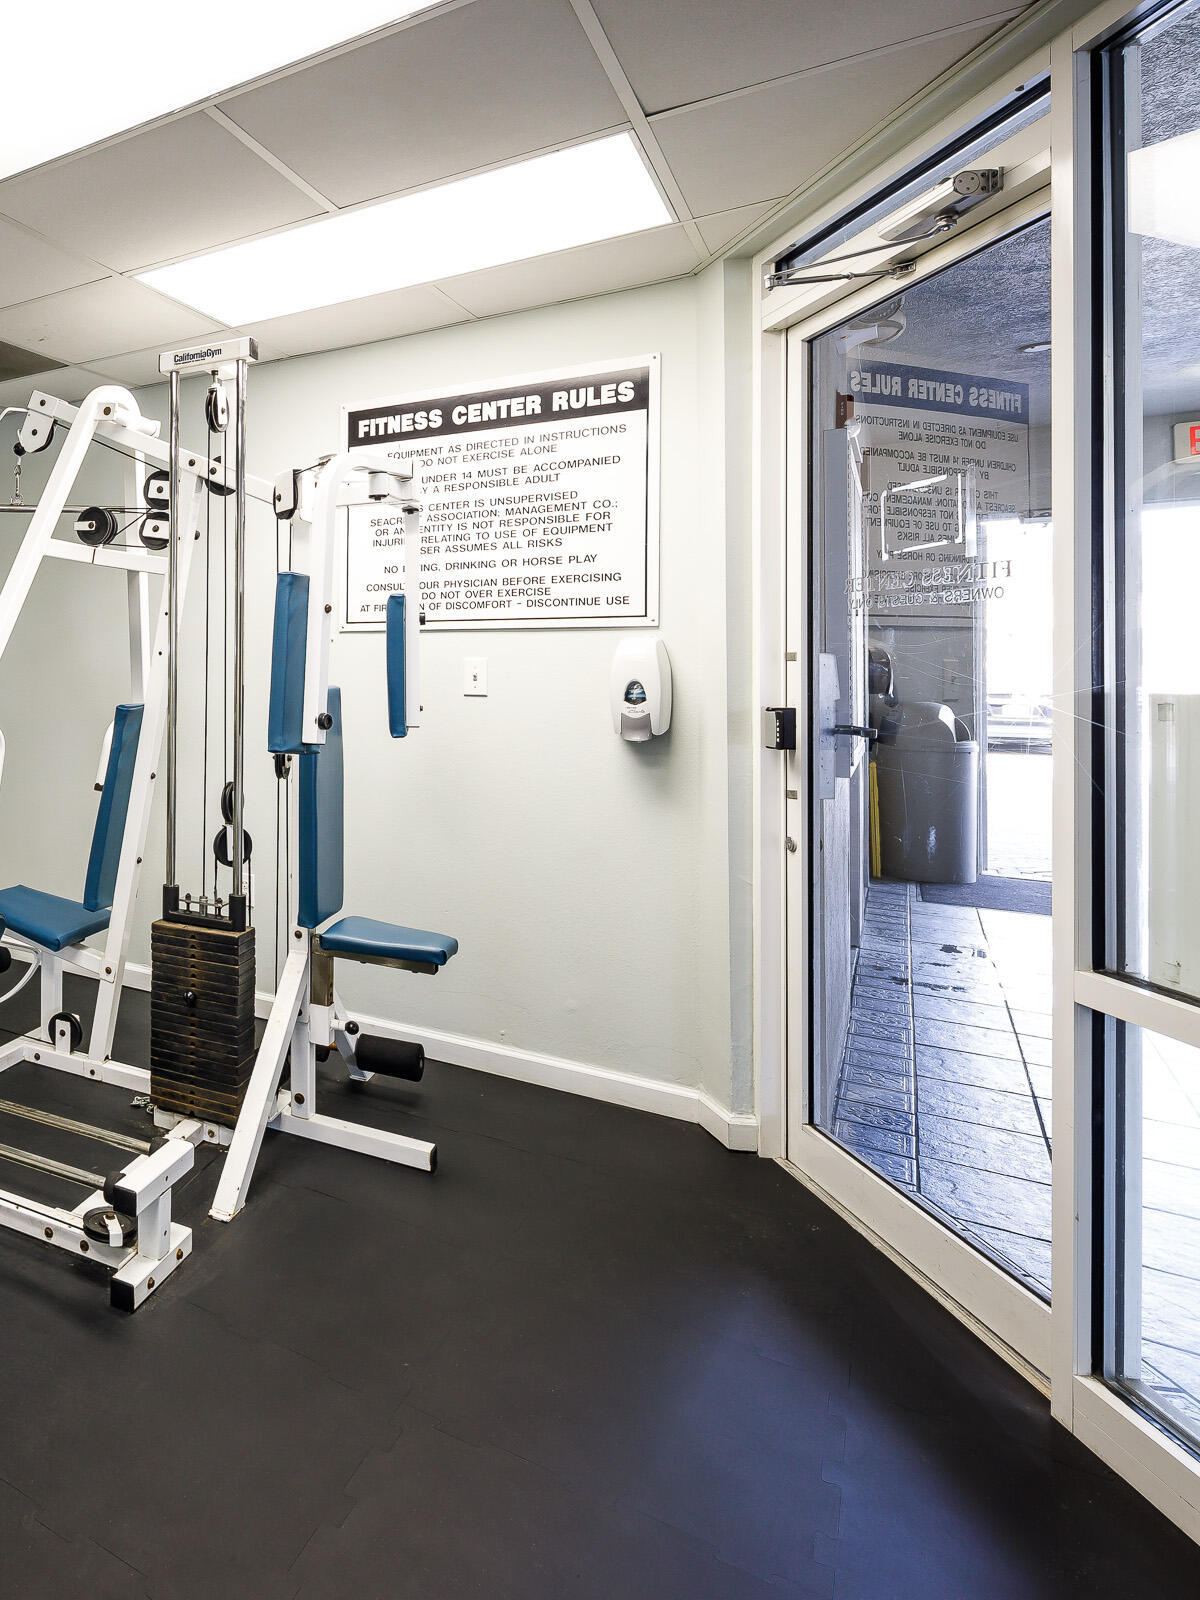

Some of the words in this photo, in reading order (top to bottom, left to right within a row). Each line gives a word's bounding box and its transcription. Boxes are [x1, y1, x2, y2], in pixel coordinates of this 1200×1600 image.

[358, 409, 443, 439] FITNESS
[451, 395, 542, 426] CENTER
[552, 380, 635, 412] RULES
[448, 443, 462, 453] AS
[466, 437, 519, 451] DIRECTED
[524, 435, 535, 444] IN
[539, 423, 627, 443] INSTRUCTIONS
[437, 455, 457, 466] NOT
[462, 449, 515, 464] EXERCISE
[520, 444, 558, 457] ALONE
[421, 473, 457, 484] UNDER
[462, 471, 472, 480] 14
[477, 467, 508, 479] MUST
[513, 465, 527, 475] BE
[533, 455, 621, 473] ACCOMPANIED
[433, 485, 440, 494] A
[444, 477, 520, 493] RESPONSIBLE
[524, 473, 561, 485] ADULT
[428, 501, 471, 513] CENTER
[474, 499, 485, 508] IS
[489, 490, 579, 507] UNSUPERVISED
[505, 500, 587, 516] MANAGEMENT
[374, 528, 389, 537] OR
[393, 527, 405, 536] AN
[457, 522, 468, 531] IS
[472, 520, 494, 530] NOT
[499, 513, 580, 529] RESPONSIBLE
[585, 511, 611, 521] FOR
[372, 537, 406, 548] INJURI
[420, 533, 472, 545] RELATING
[476, 531, 490, 541] TO
[494, 529, 517, 539] USE
[522, 527, 537, 537] OF
[542, 522, 614, 536] EQUIPMENT
[419, 546, 441, 555] SER
[444, 542, 497, 553] ASSUMES
[502, 540, 523, 549] ALL
[527, 537, 563, 548] RISKS
[384, 565, 399, 574] NO
[445, 559, 497, 571] DRINKING
[501, 558, 518, 568] OR
[522, 555, 563, 567] HORSE
[568, 553, 598, 565] PLAY
[366, 582, 406, 592] CONSUL
[418, 581, 440, 590] OUR
[443, 577, 498, 589] PHYSICIAN
[502, 575, 546, 586] BEFORE
[551, 572, 622, 585] EXERCISING
[421, 591, 436, 600] DO
[440, 591, 461, 599] NOT
[464, 589, 493, 599] OVER
[497, 587, 552, 598] EXERCISE
[360, 604, 371, 613] AT
[428, 602, 442, 611] OF
[445, 600, 511, 610] DISCOMFORT
[526, 598, 601, 608] DISCONTINUE
[606, 596, 630, 605] USE
